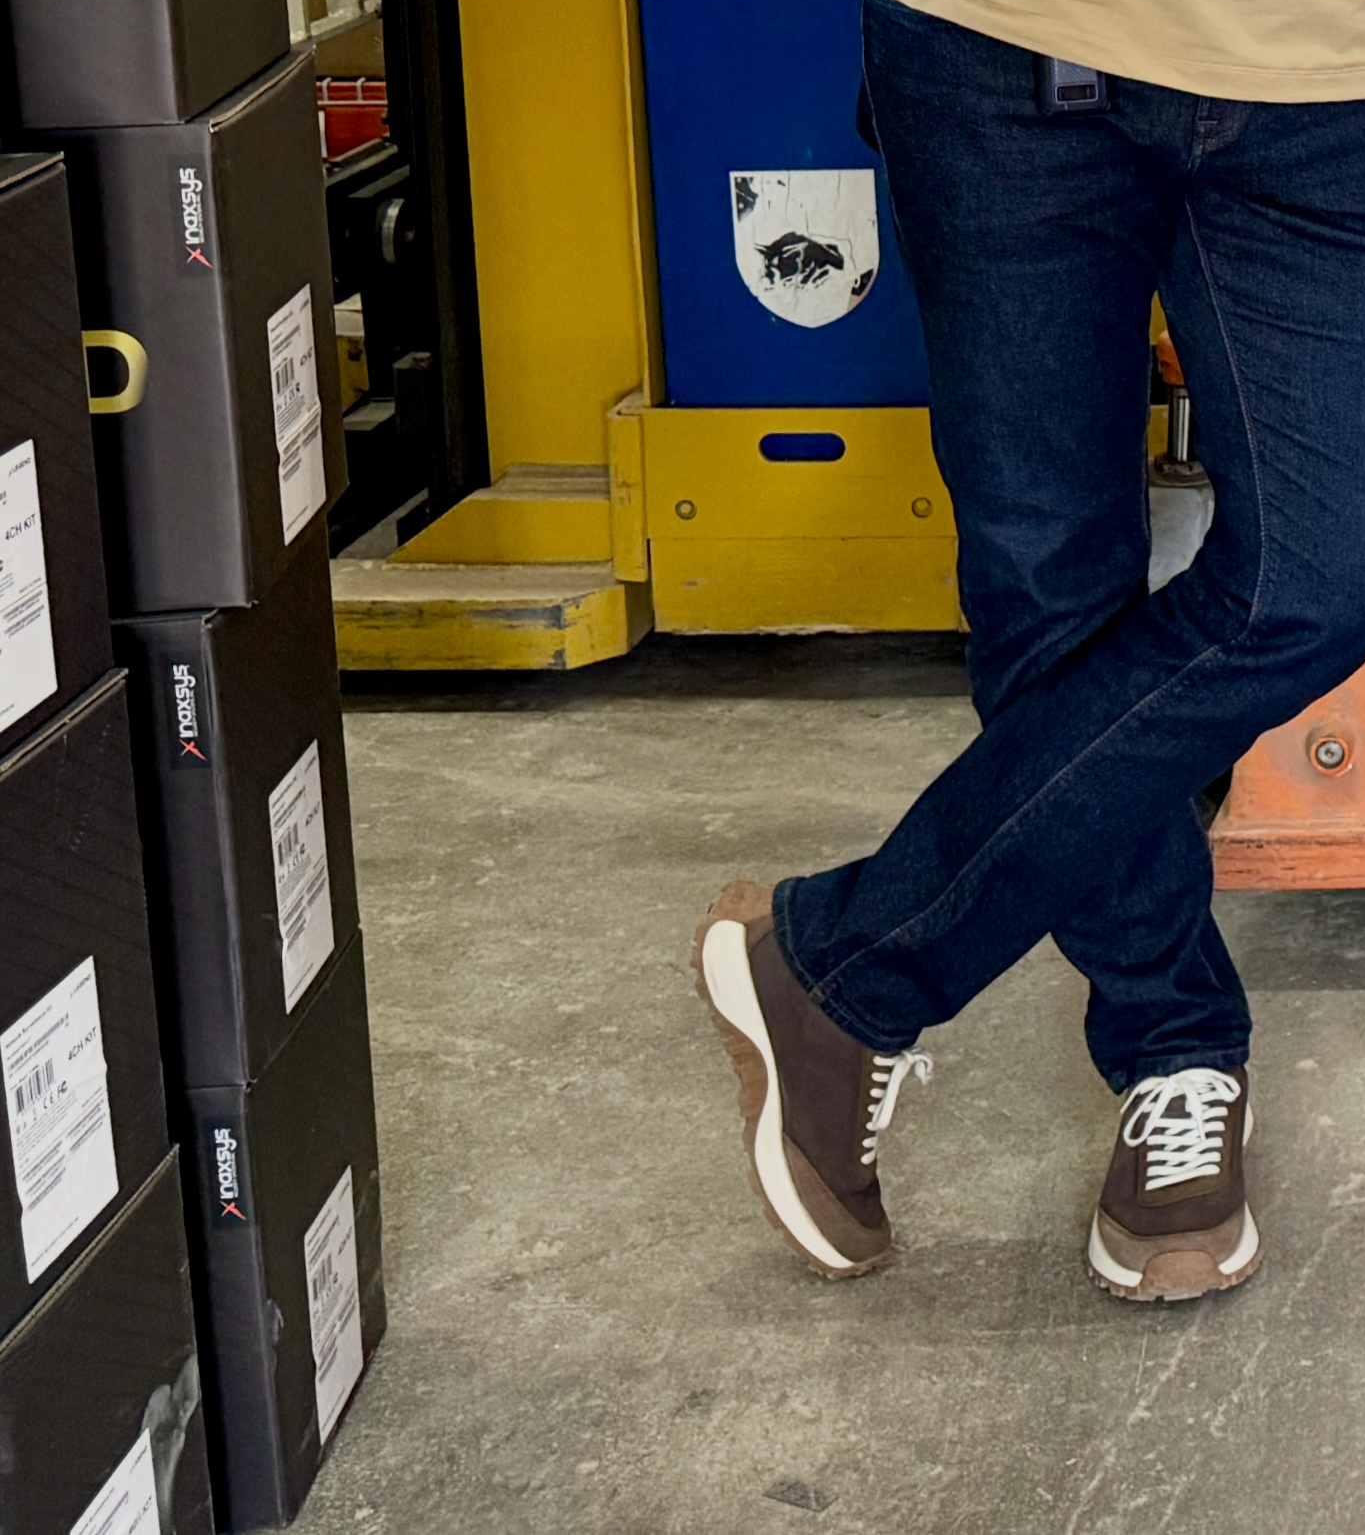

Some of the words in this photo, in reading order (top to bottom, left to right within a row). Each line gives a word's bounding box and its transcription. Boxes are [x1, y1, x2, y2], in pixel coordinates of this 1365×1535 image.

[180, 167, 203, 244] inaxsys
[173, 664, 196, 738] inaxsys
[68, 1040, 84, 1061] 4CH
[85, 1026, 97, 1048] KIT
[215, 1127, 238, 1199] inaxsys
